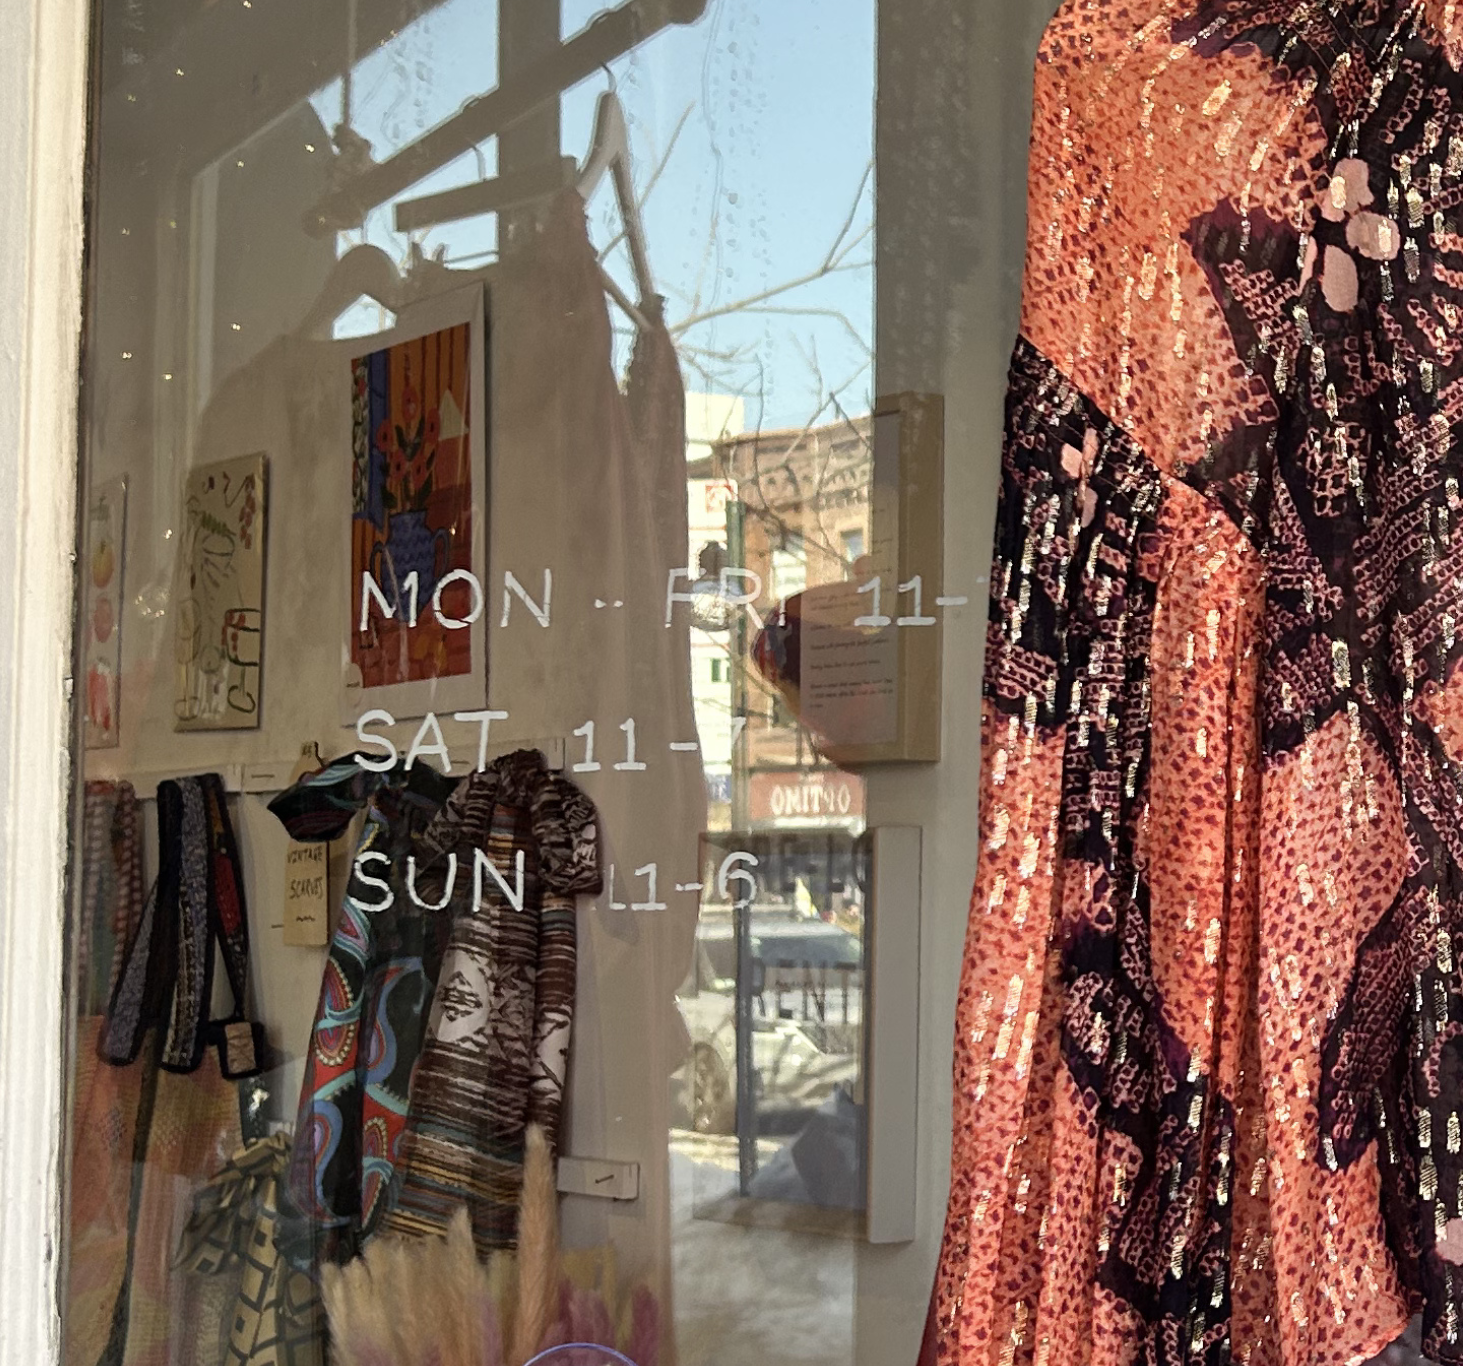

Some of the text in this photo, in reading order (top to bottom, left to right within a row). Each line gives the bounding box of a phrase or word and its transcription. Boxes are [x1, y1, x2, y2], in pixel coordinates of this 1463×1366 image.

[360, 568, 552, 632] MON
[353, 709, 509, 773] SAT
[350, 847, 526, 913] SUN
